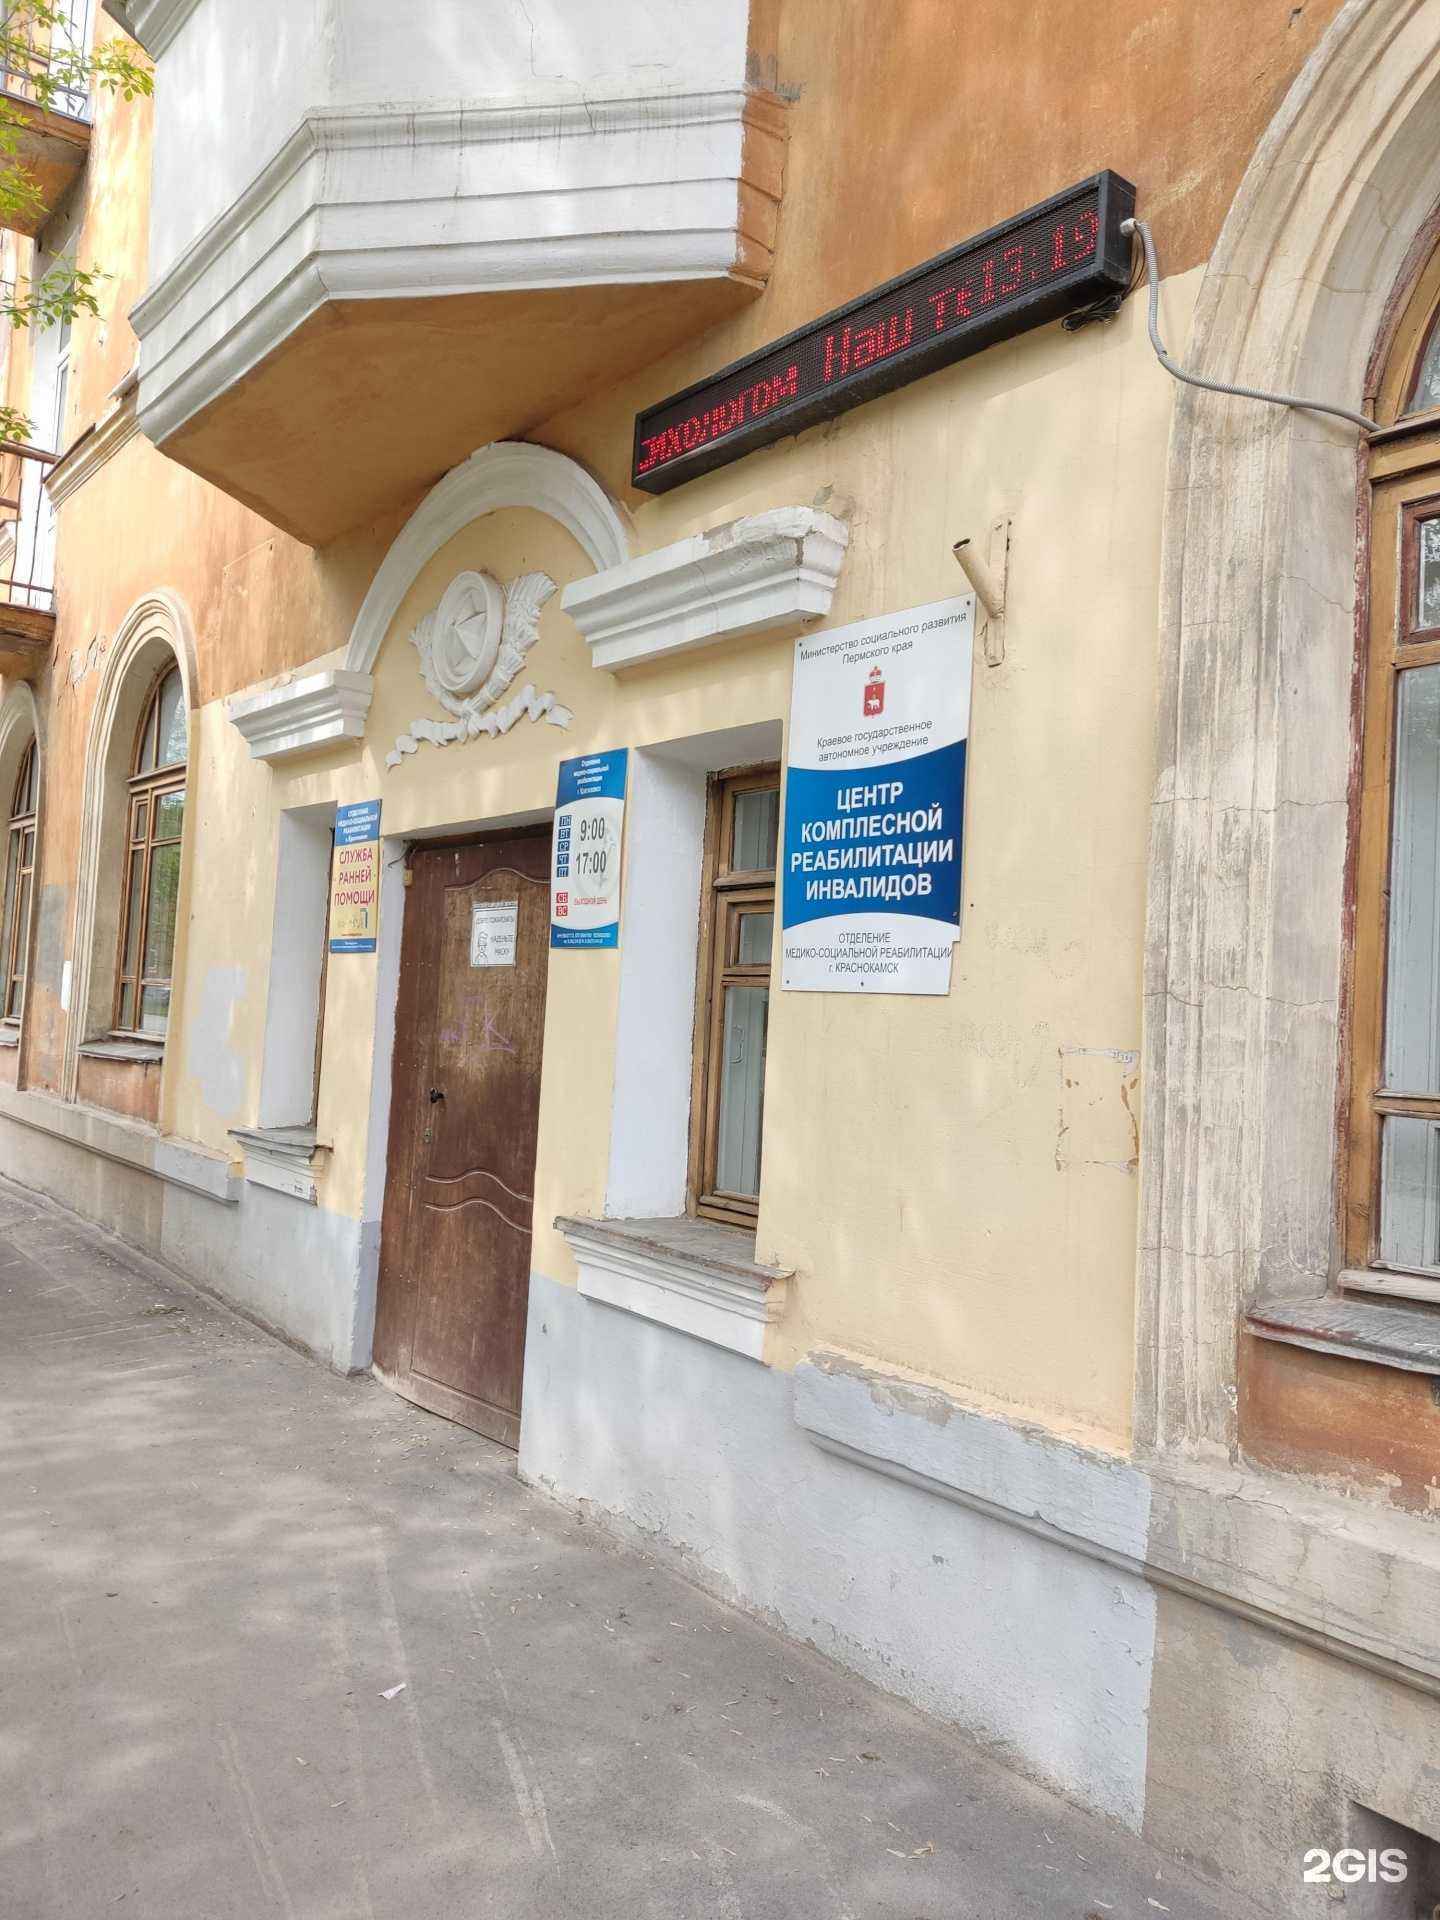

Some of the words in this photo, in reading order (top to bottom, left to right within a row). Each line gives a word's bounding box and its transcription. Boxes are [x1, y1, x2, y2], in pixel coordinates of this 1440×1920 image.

[823, 307, 912, 382] Наш
[800, 641, 859, 661] Министерство
[860, 624, 919, 646] социального
[921, 612, 967, 633] развития
[842, 645, 889, 665] Пермского
[891, 640, 914, 655] края
[817, 735, 852, 749] Краевое
[854, 719, 933, 743] государственное
[818, 747, 870, 763] автономное
[872, 736, 929, 756] учреждение
[836, 781, 904, 813] ЦЕНТР
[580, 817, 605, 841] 9:00
[801, 802, 943, 844] КОМПЛЕСНОЙ
[339, 848, 373, 864] СЛУЖБА
[576, 851, 607, 875] 17:00
[791, 838, 954, 873] РЕАБИЛИТАЦИИ
[338, 866, 372, 885] РАННЕЙ
[806, 873, 933, 901] ИНВАЛИДОВ
[334, 891, 375, 906] ПОМОЩИ
[838, 932, 891, 944] ОТДЕЛЕНИЕ
[785, 945, 878, 960] МЕДИКО-СОЦИАЛЬНОЙ
[879, 947, 952, 960] РЕАБИЛИТАЦИИ
[835, 962, 899, 974] КРАСНОКАМСК
